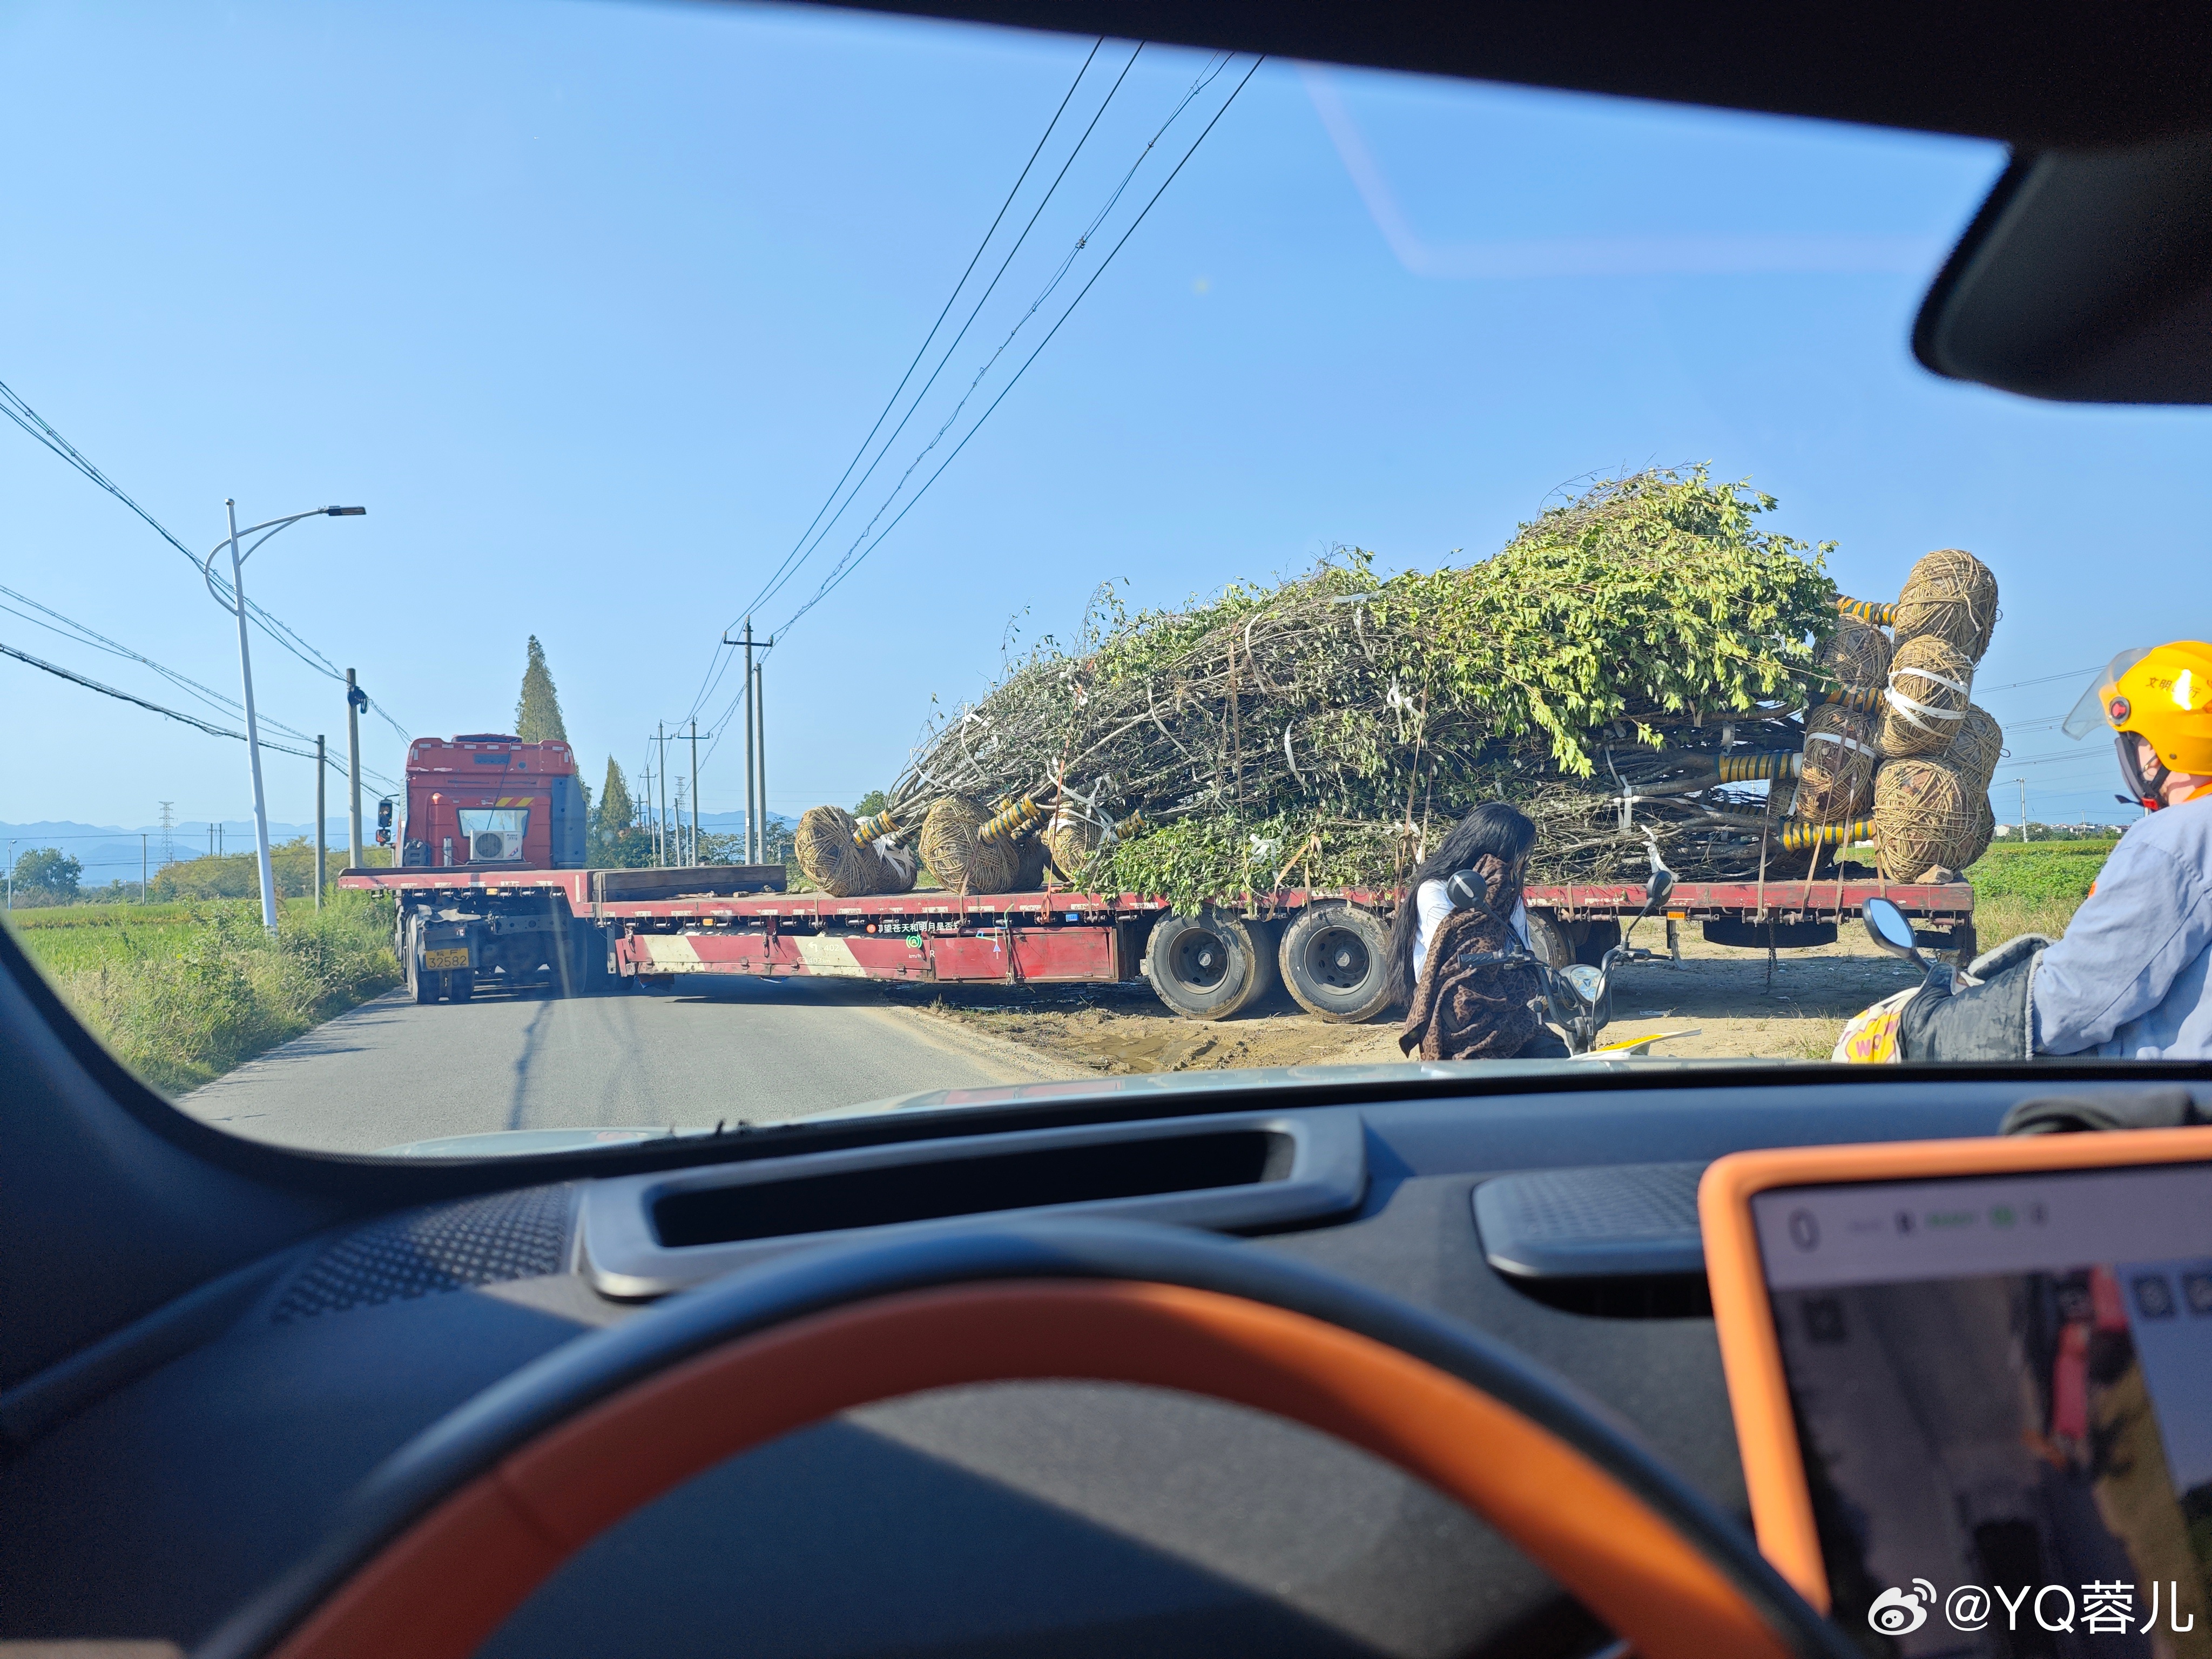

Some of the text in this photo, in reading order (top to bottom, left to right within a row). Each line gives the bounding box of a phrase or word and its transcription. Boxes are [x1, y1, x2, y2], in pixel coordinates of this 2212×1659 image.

[2146, 677, 2202, 698] 文明行
[929, 949, 935, 958] R
[429, 955, 467, 968] 32582
